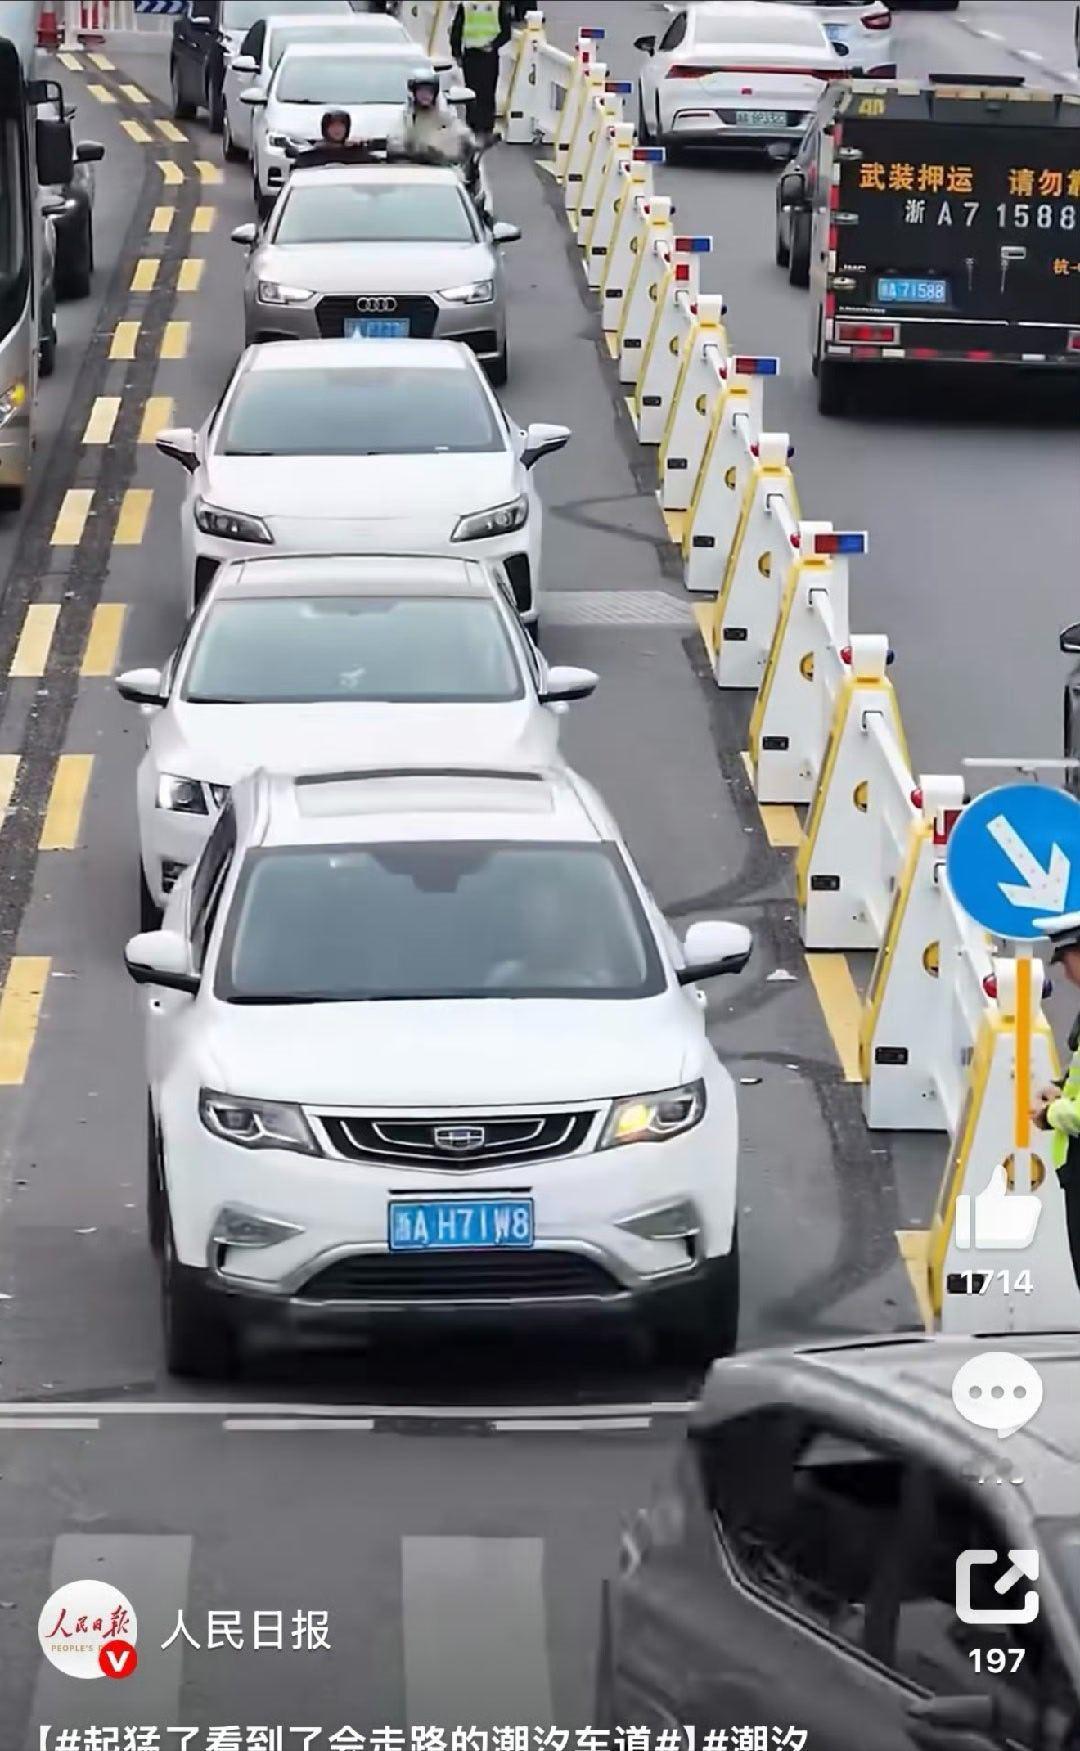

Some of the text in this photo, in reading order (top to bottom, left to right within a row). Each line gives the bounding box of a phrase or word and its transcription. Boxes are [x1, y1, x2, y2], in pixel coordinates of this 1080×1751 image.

[859, 162, 973, 193] 武装押运
[905, 199, 1076, 230] 浙A71588
